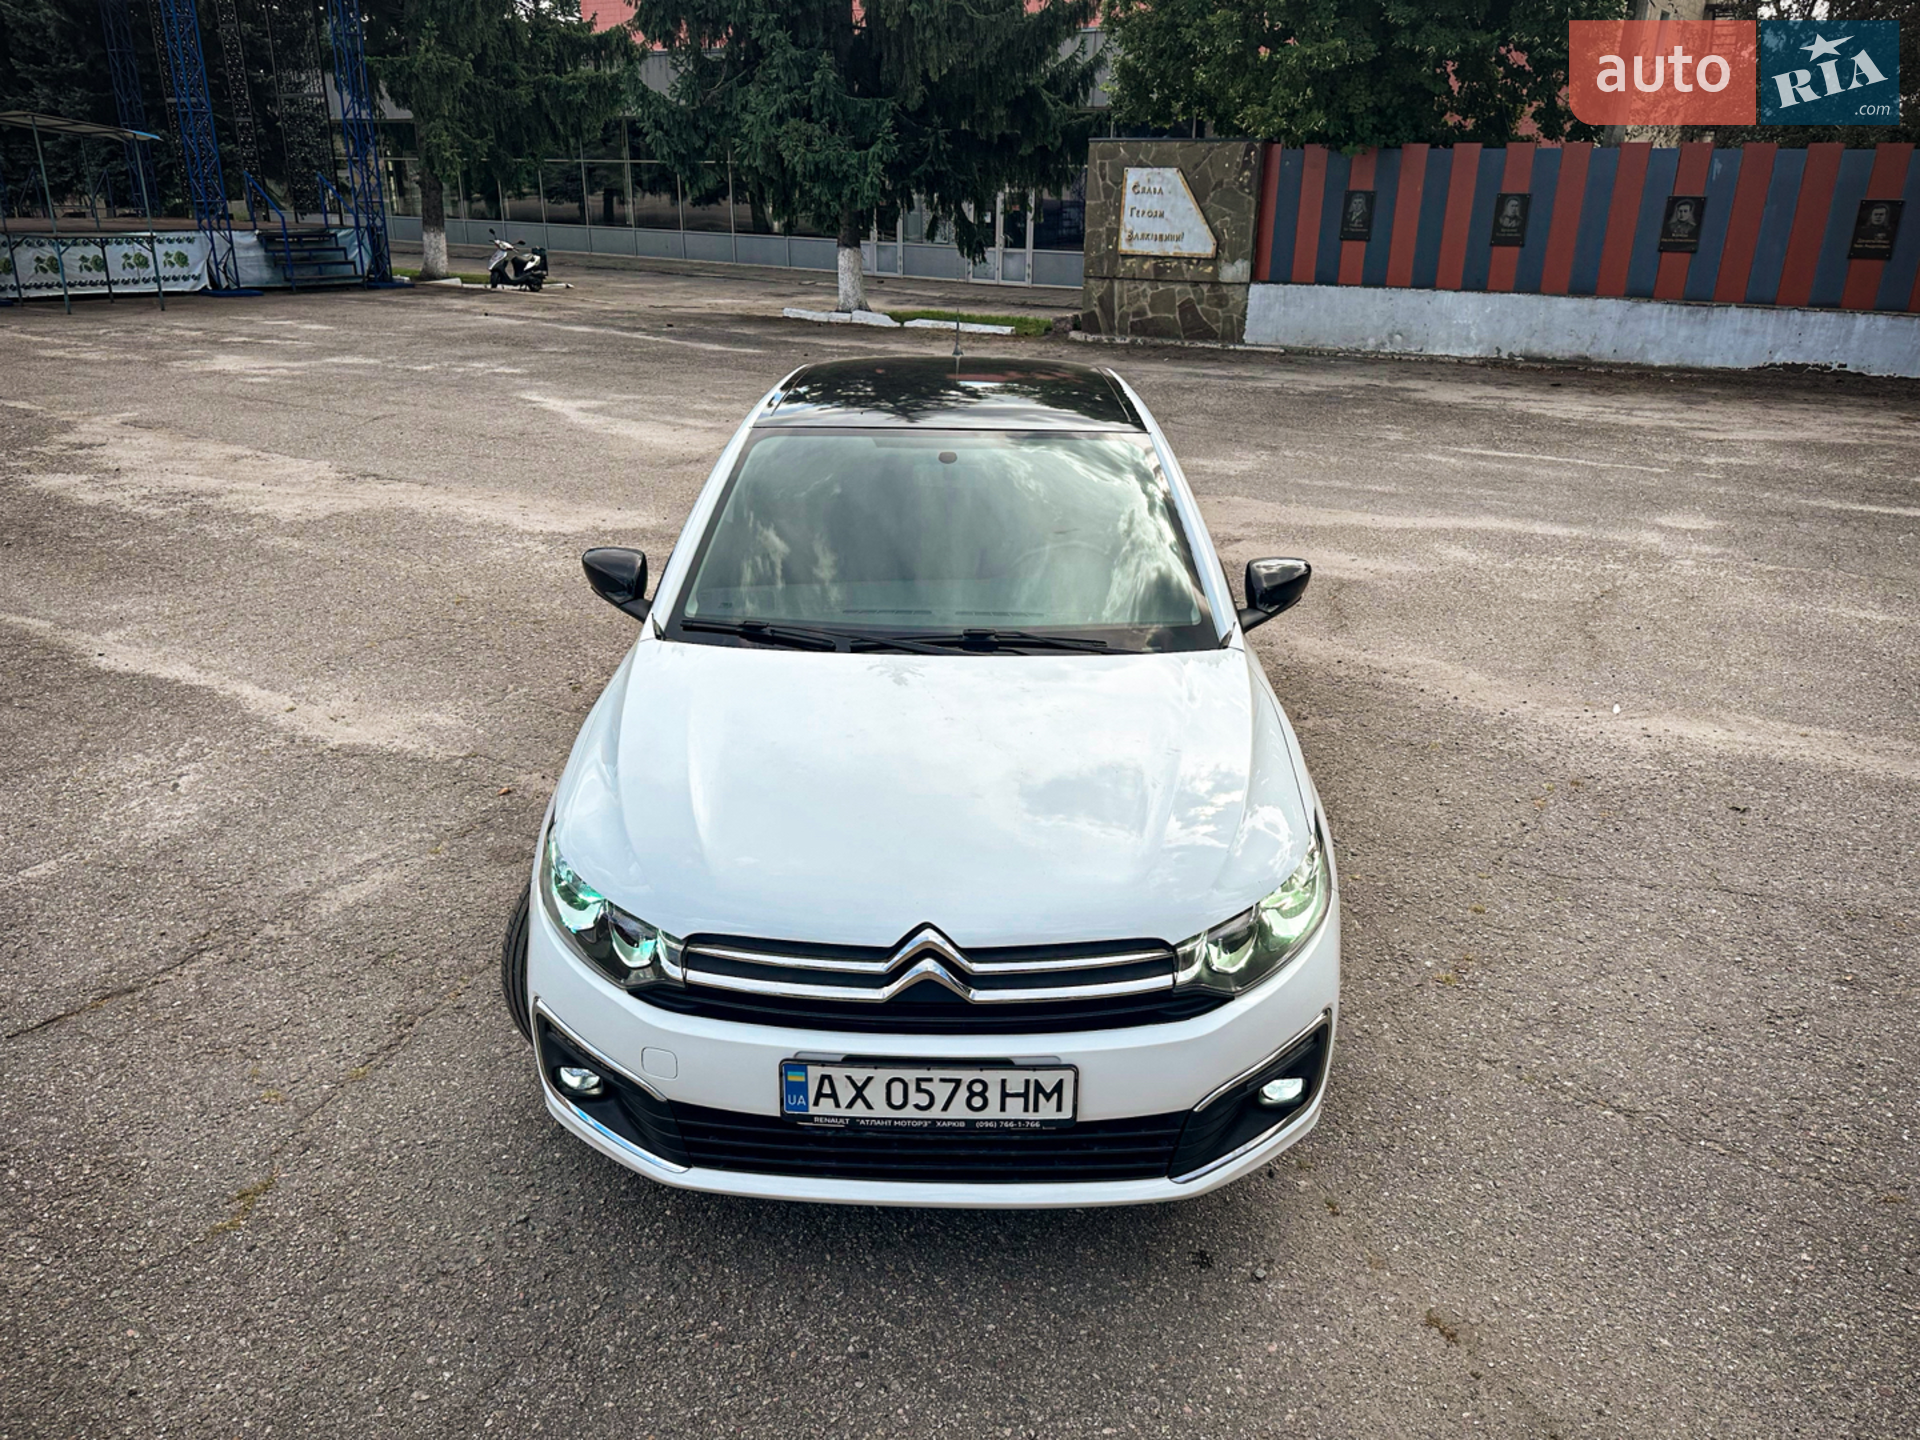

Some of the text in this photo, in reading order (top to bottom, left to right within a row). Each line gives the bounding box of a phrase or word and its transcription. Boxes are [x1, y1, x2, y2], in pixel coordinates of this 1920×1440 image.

[812, 1074, 1064, 1113] AX 0578 HM
[787, 1094, 807, 1107] UA
[813, 1116, 850, 1125] RENAULT
[975, 1121, 997, 1129] (096)
[999, 1121, 1041, 1129] 766-1-766
